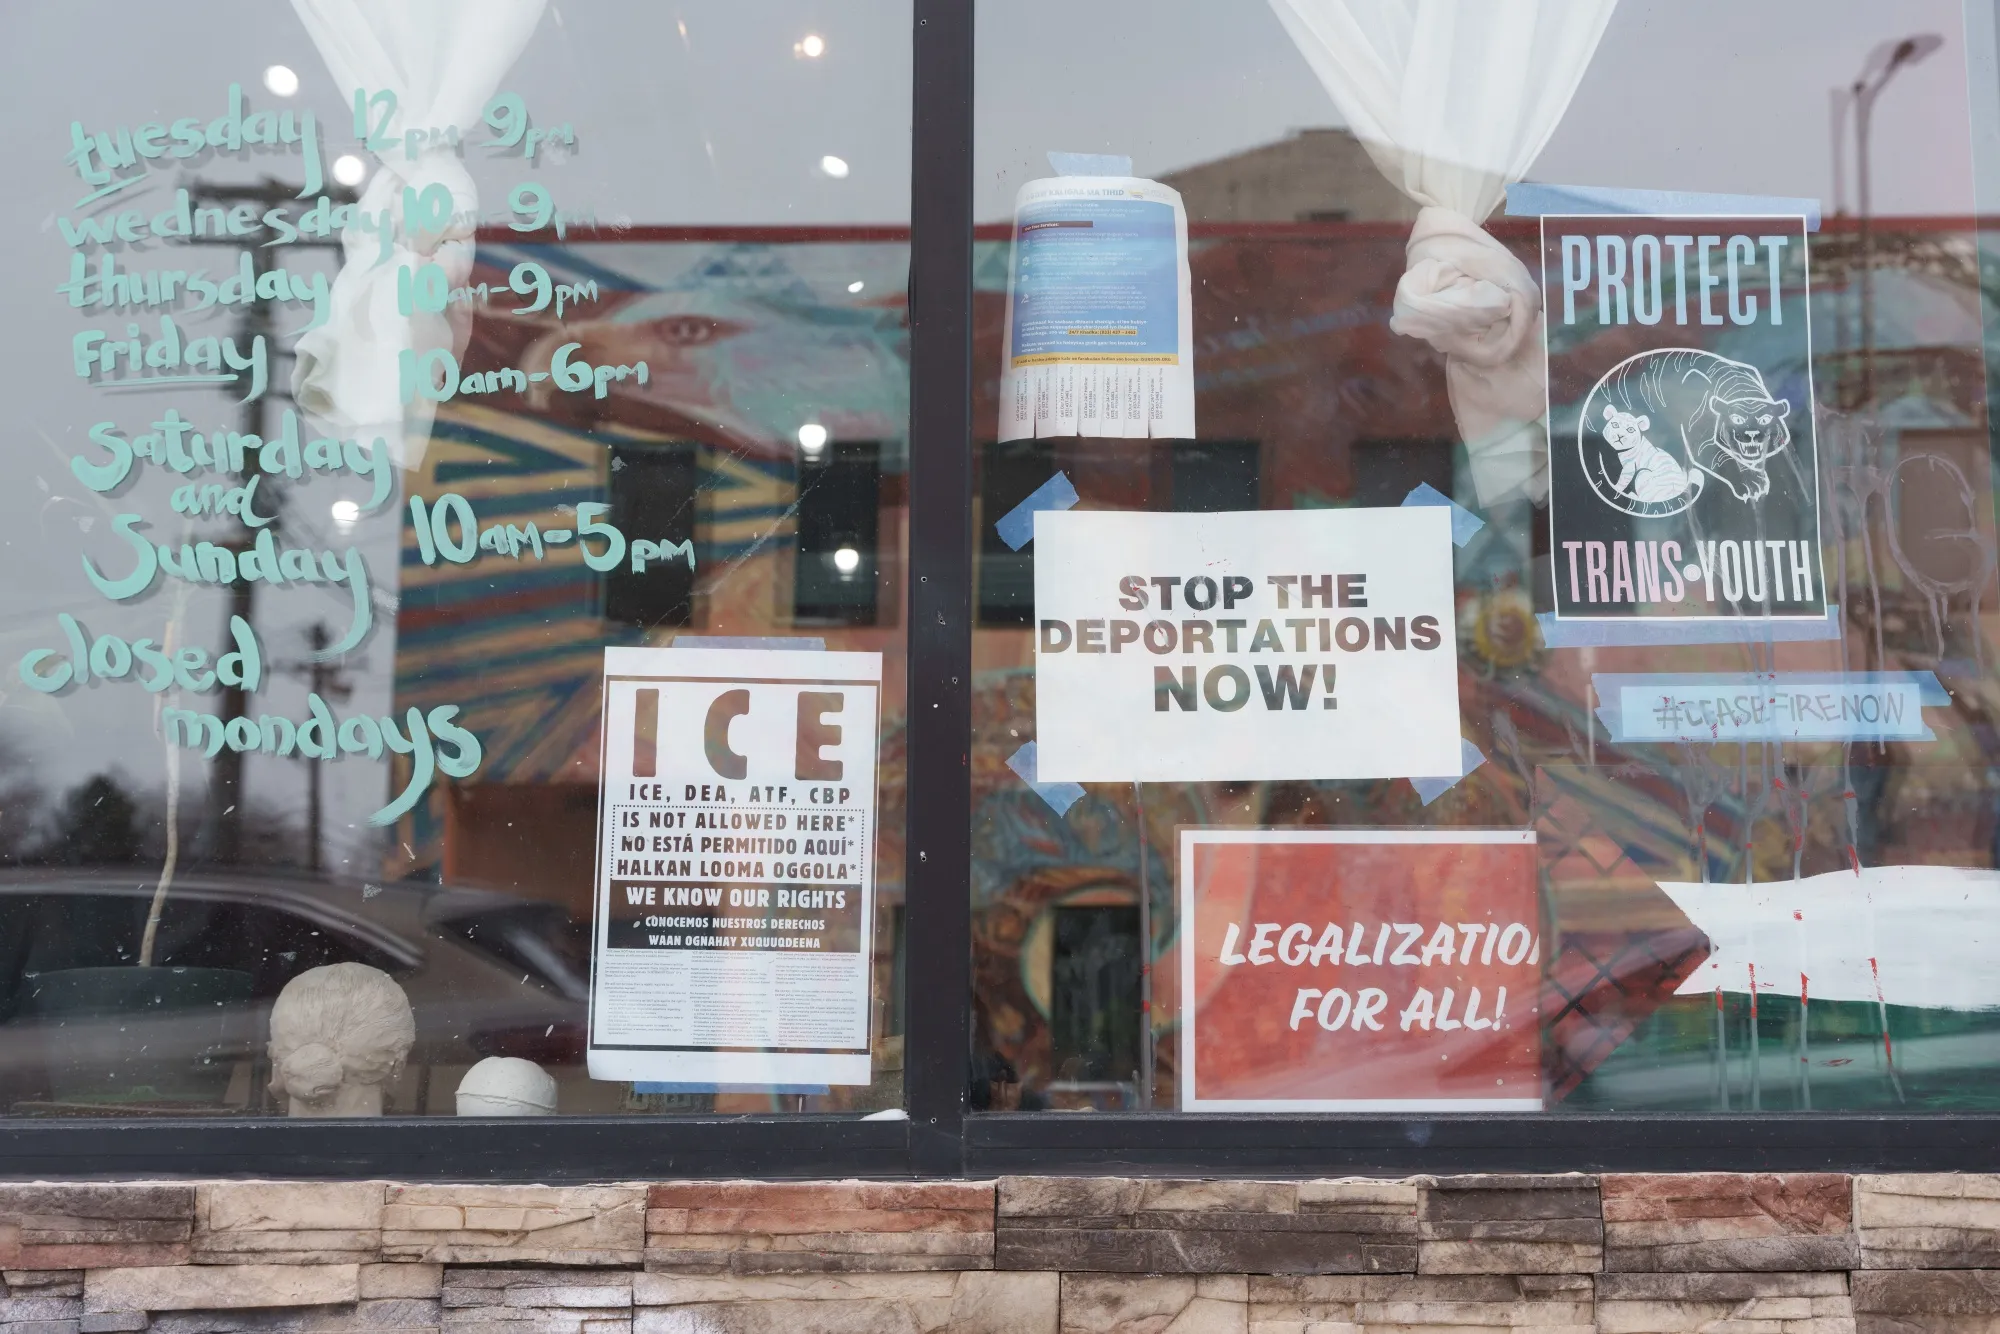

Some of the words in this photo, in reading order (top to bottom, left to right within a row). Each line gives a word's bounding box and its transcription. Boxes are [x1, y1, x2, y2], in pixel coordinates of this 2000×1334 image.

[64, 83, 323, 198] tuesday
[57, 188, 394, 266] wednesday
[55, 251, 332, 335] thursday
[1562, 234, 1788, 326] PROTECT
[73, 316, 267, 405] Friday
[71, 409, 392, 514] Saturday
[170, 474, 278, 527] and
[83, 513, 372, 661] Sunday
[1119, 575, 1253, 611] STOP
[1268, 573, 1368, 609] THE
[1562, 540, 1683, 603] TRANS
[1696, 539, 1814, 603] YOUTH
[20, 613, 262, 692] closed
[1040, 615, 1441, 654] DEPORTATIONS
[1154, 663, 1338, 712] NOW!
[163, 693, 482, 825] mondays
[633, 688, 844, 781] ICE
[629, 784, 671, 802] ICE,
[685, 785, 735, 803] DEA,
[749, 786, 796, 804] ATF,
[809, 787, 850, 804] CBP
[622, 812, 640, 828] IS
[650, 812, 686, 828] NOT
[695, 812, 787, 830] ALLOWED
[622, 836, 645, 852] NO
[653, 833, 693, 852] ESTÁ
[701, 837, 796, 854] PERMITIDO
[617, 859, 691, 876] HALKAN
[700, 860, 764, 878] LOOMA
[626, 887, 656, 905] WE
[664, 887, 722, 907] KNOW
[730, 889, 769, 907] OUR
[777, 890, 846, 909] RIGHTS
[645, 917, 709, 929] CONOCEMOS
[712, 917, 767, 929] NUESTROS
[770, 918, 825, 930] DERECHOS
[649, 935, 682, 946] WAAN
[685, 935, 737, 947] OGNAHAY
[740, 936, 820, 949] XUQUUQDEENA
[1219, 921, 1540, 967] LEGALIZATIO
[1289, 987, 1388, 1032] FOR
[1400, 986, 1507, 1032] ALL!
